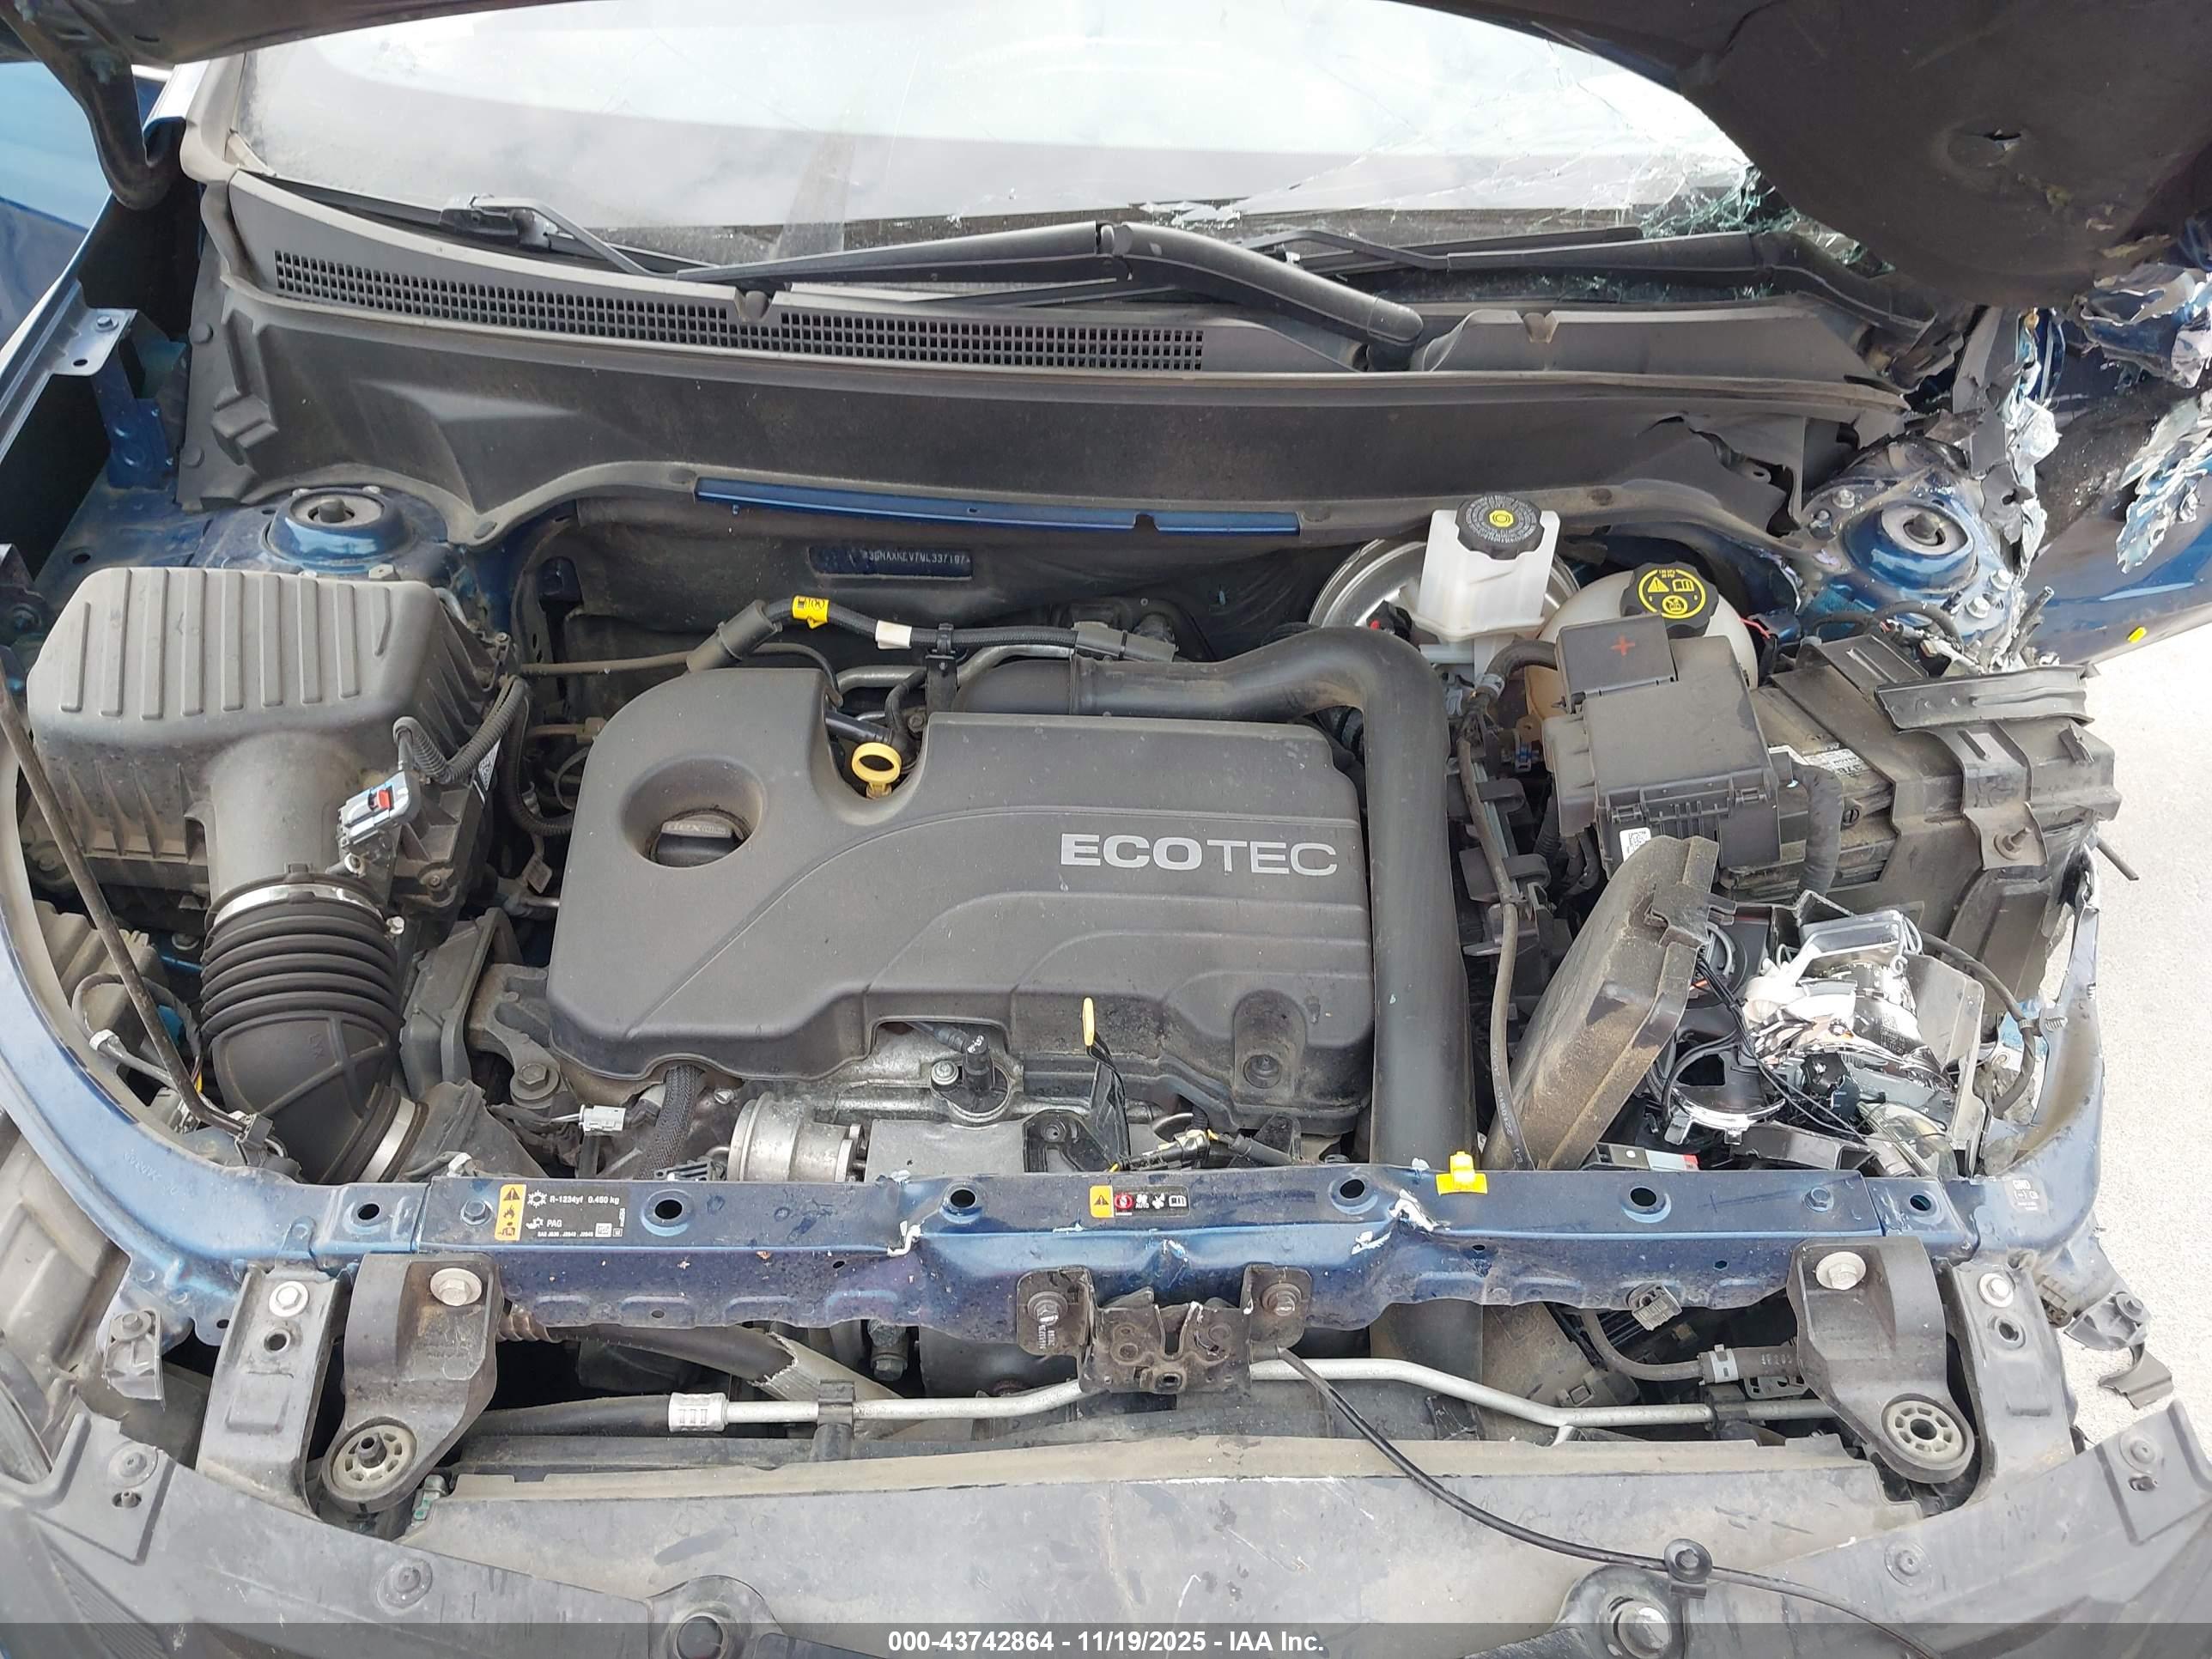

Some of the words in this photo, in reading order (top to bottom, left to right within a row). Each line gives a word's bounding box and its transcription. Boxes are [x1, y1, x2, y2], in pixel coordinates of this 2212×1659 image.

[1060, 833, 1338, 876] ECOTEC
[610, 1195, 620, 1206] kg
[546, 1218, 562, 1228] PAG
